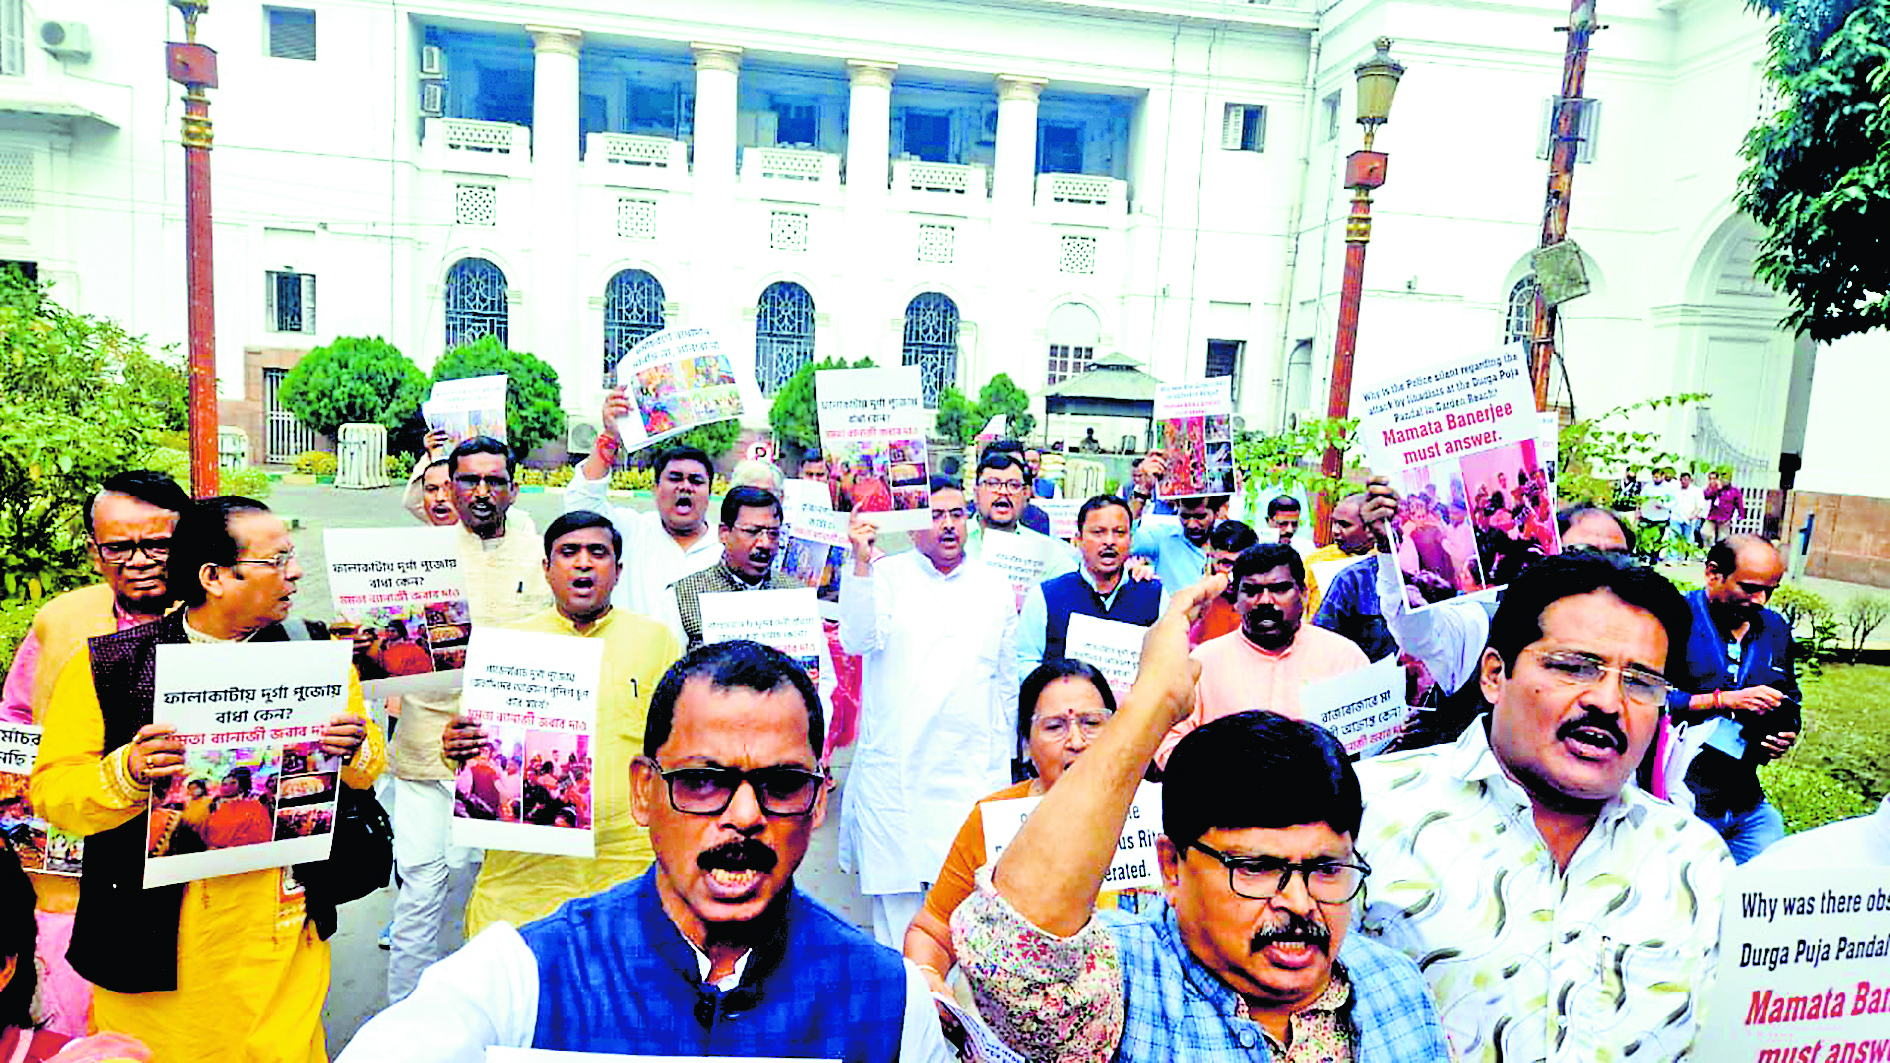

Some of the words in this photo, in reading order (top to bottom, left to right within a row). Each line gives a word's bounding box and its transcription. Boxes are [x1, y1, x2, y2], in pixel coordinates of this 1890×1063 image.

[1363, 390, 1380, 402] Why
[1381, 387, 1390, 397] is
[1391, 383, 1404, 394] the
[1406, 376, 1432, 389] Police
[1460, 357, 1502, 375] regarding
[1503, 353, 1518, 363] the
[1456, 380, 1470, 392] the
[1471, 374, 1498, 387] Durga
[1499, 368, 1519, 380] Puja
[1425, 405, 1434, 415] in
[1382, 421, 1443, 447] Mamata
[1446, 402, 1513, 430] Banerjee
[1403, 440, 1442, 465] must
[1445, 429, 1503, 455] answer.
[164, 687, 257, 704] ফালাকাটায়
[1380, 689, 1391, 703] মা
[215, 710, 250, 724] বাধা
[253, 708, 293, 722] কেন?
[270, 726, 308, 740] জবাব
[1105, 860, 1151, 882] erated.
[1741, 892, 1778, 923] Why
[1783, 896, 1816, 916] was
[1820, 889, 1862, 914] there
[1866, 887, 1890, 912] obs
[1739, 942, 1790, 972] Durga
[1793, 938, 1831, 969] Puja
[1835, 934, 1890, 960] Pandal
[1745, 987, 1846, 1026] Mamata
[1850, 981, 1890, 1016] Ban
[1825, 1039, 1890, 1063] answ
